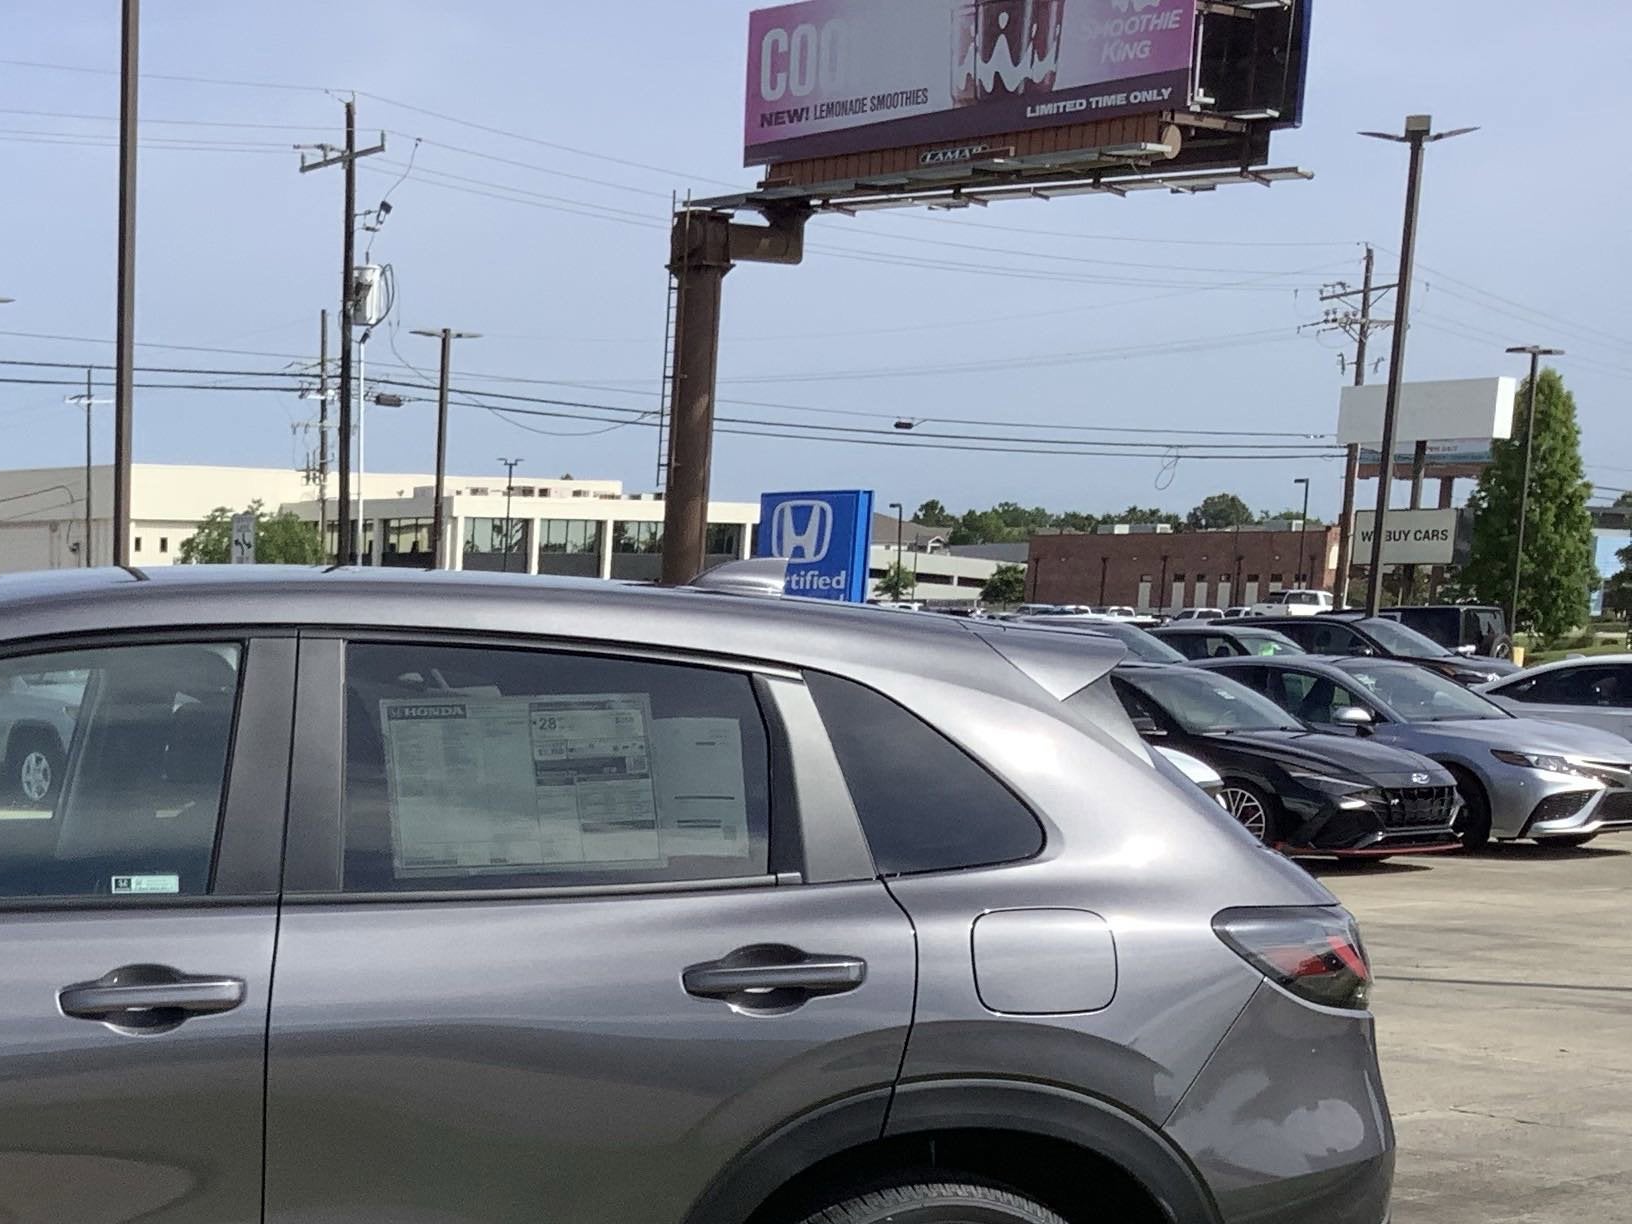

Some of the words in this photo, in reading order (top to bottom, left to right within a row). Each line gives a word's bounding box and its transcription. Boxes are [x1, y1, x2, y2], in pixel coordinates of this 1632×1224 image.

[1080, 9, 1183, 40] MOOTHIE
[1100, 40, 1152, 64] KING
[760, 106, 809, 128] NEW!
[814, 98, 868, 121] LEMONADE
[870, 88, 929, 112] SMOOTHIES
[1026, 99, 1087, 118] LIMITED
[1089, 93, 1128, 109] TIME
[1130, 87, 1172, 104] ONLY
[1413, 529, 1449, 541] CARS
[786, 570, 846, 590] tified
[404, 706, 465, 717] HONDA
[539, 717, 557, 730] 28
